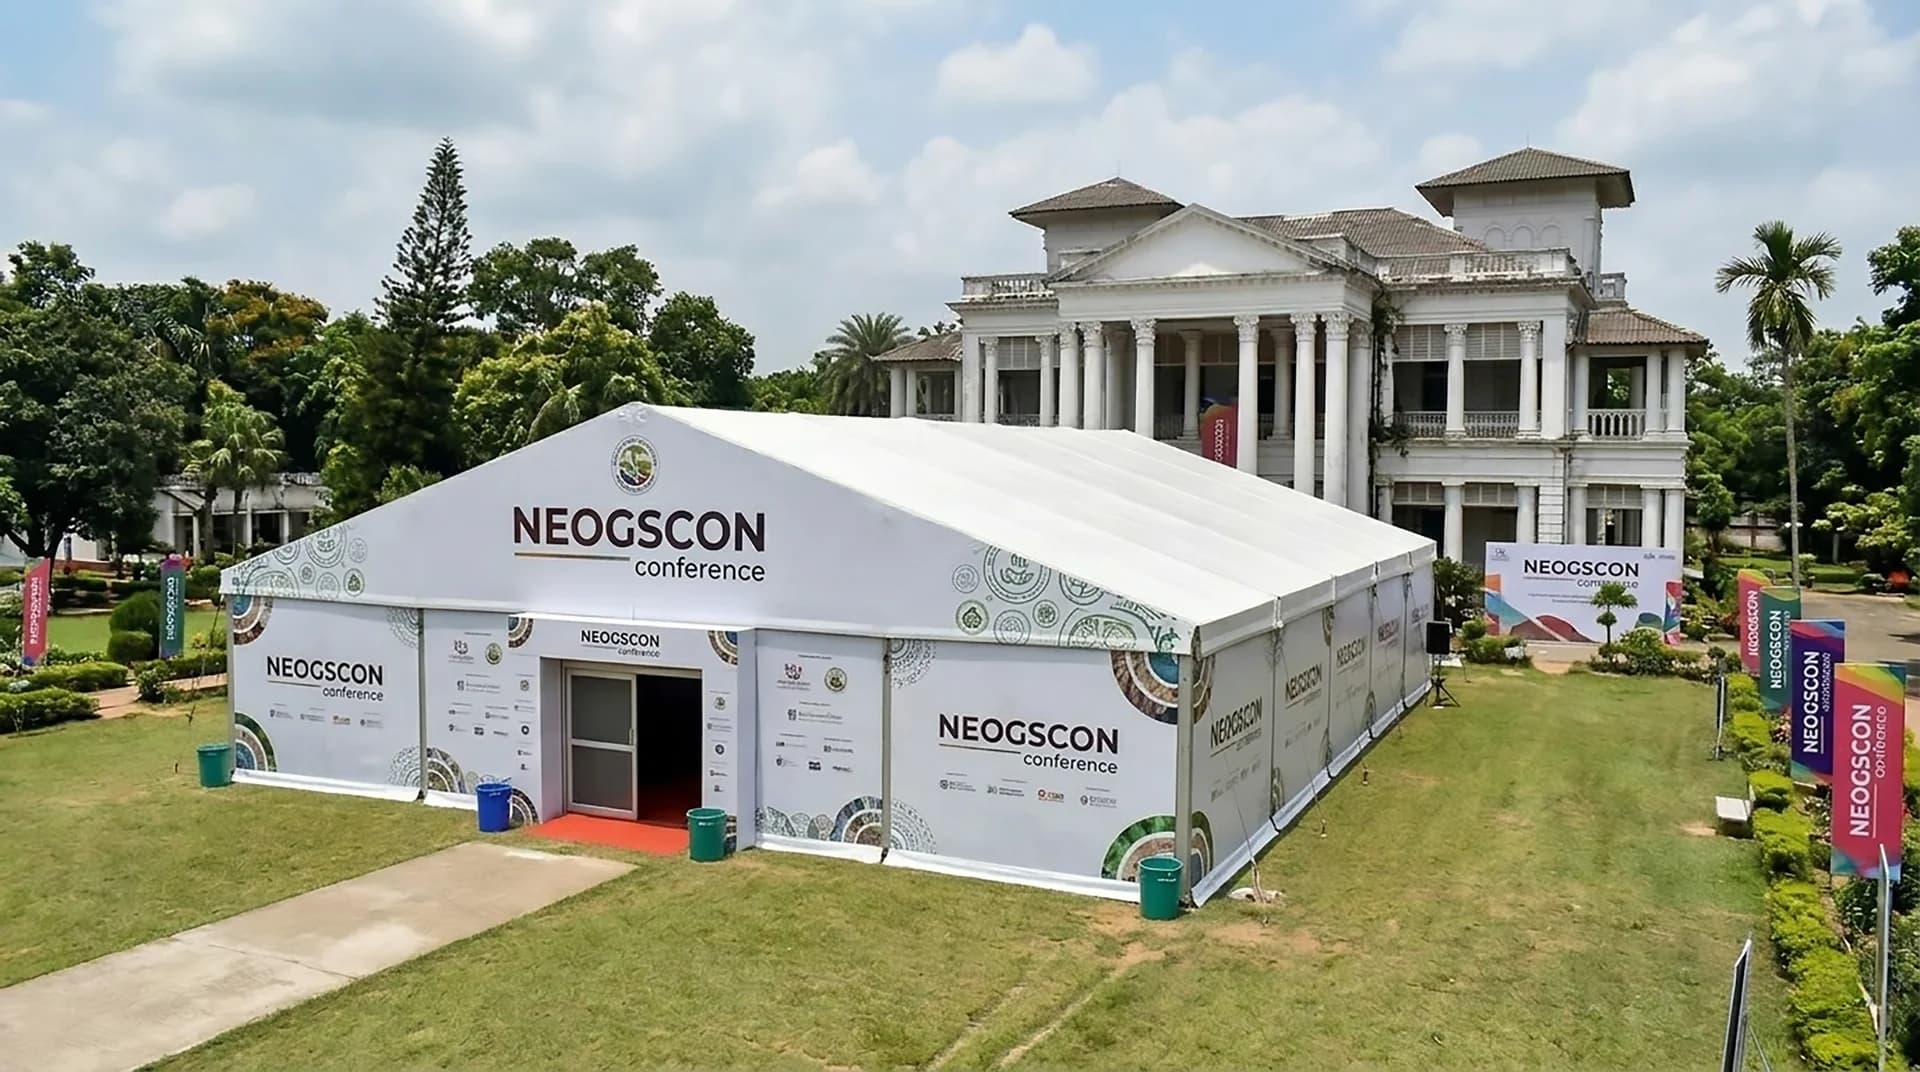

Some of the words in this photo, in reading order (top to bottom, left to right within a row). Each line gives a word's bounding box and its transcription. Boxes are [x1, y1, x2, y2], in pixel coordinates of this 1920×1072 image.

[513, 506, 766, 552] NEOGSCON
[635, 556, 766, 582] conference
[1524, 559, 1639, 577] NEOGSCON
[581, 630, 660, 648] NEOGSCON
[1769, 610, 1782, 689] NEOGSCON
[266, 655, 383, 686] NEOGSCON
[322, 686, 384, 701] conference
[1803, 651, 1820, 753] NEOGSCON
[938, 713, 1119, 755] NEOGSCON
[1023, 754, 1118, 774] conference
[1849, 704, 1872, 837] NEOGSCON
